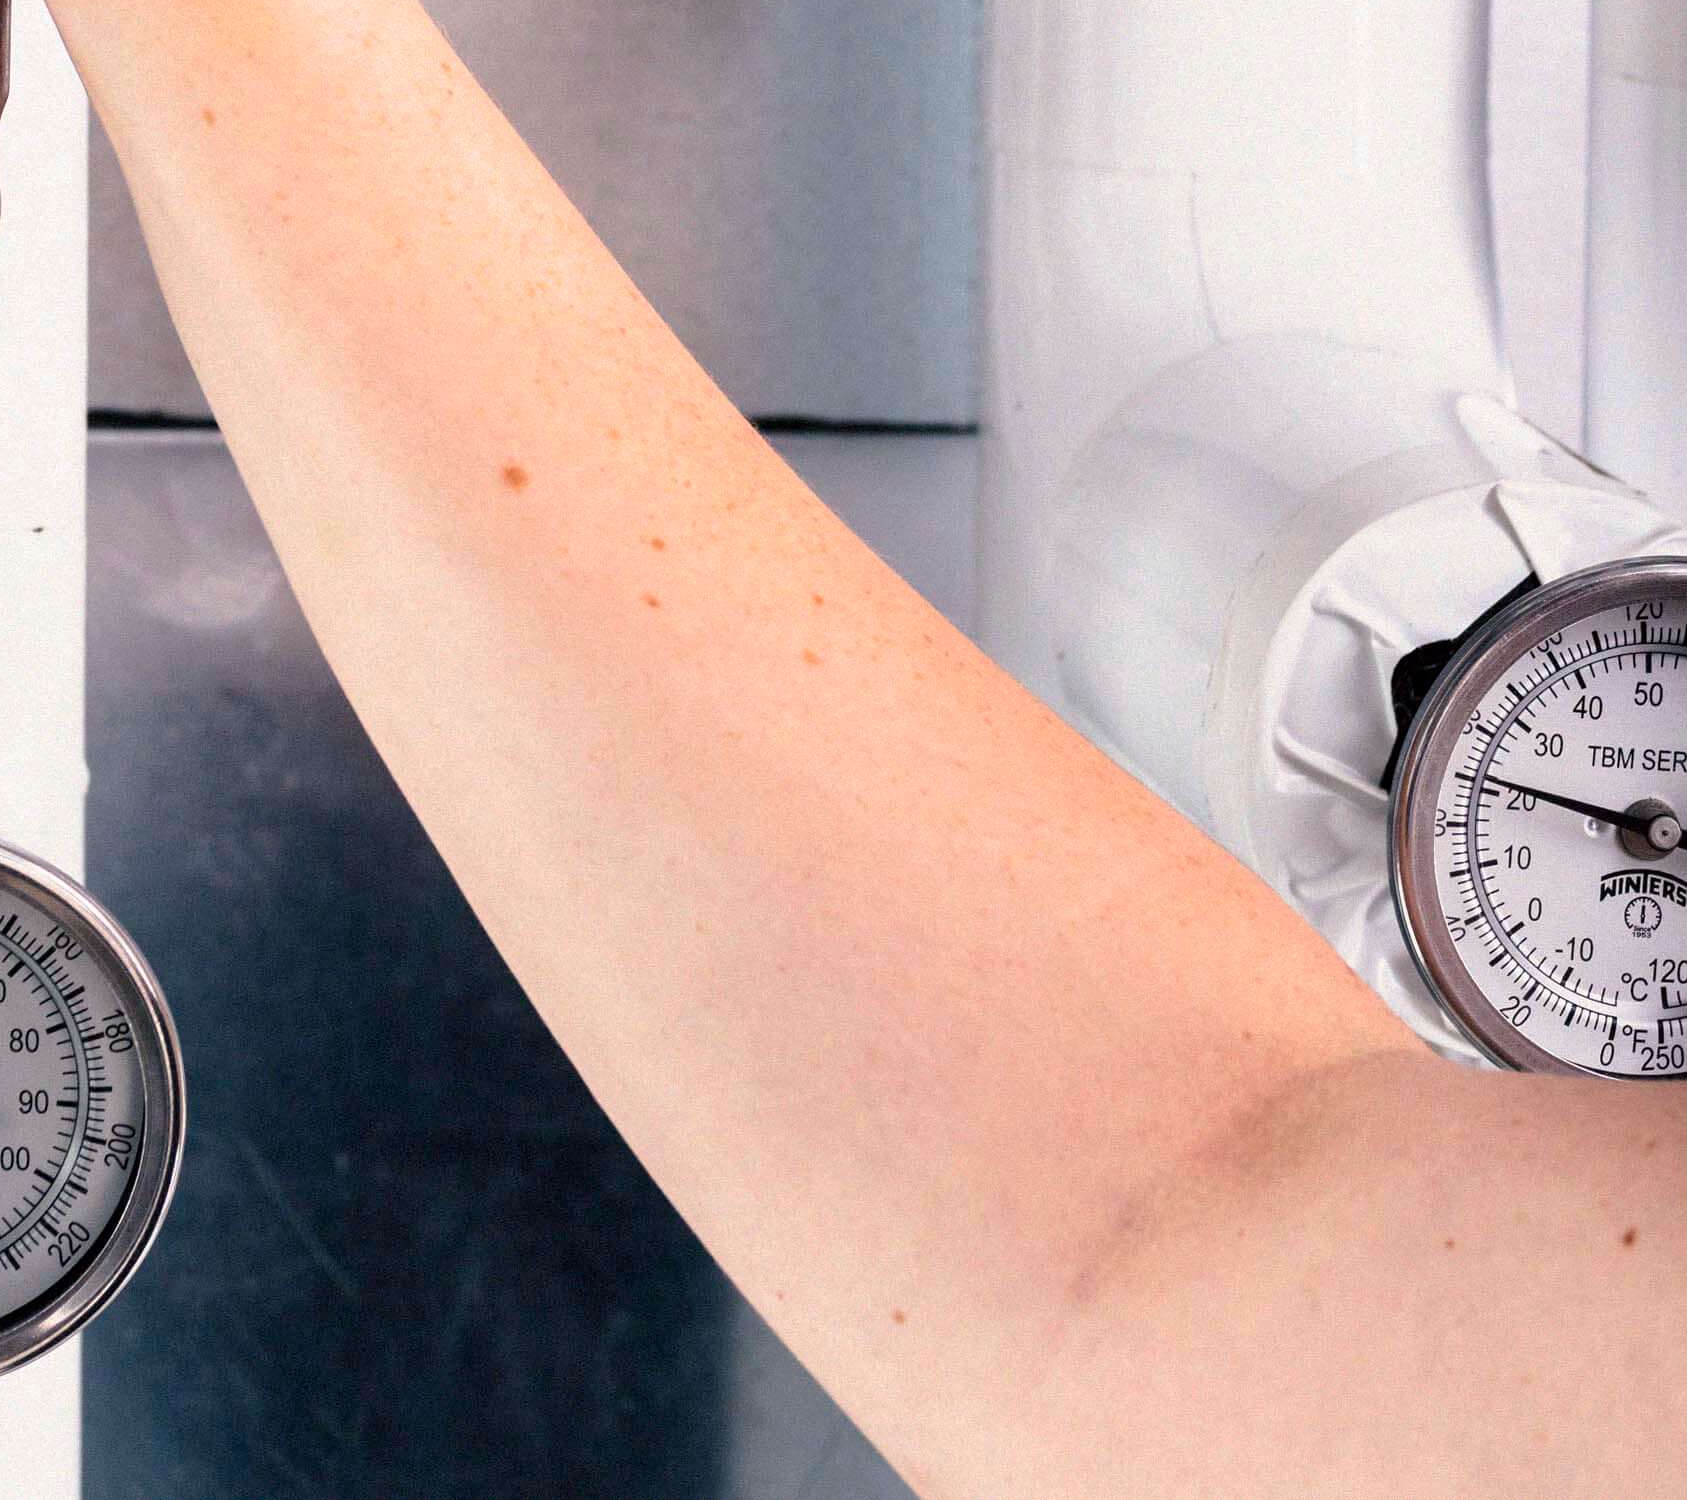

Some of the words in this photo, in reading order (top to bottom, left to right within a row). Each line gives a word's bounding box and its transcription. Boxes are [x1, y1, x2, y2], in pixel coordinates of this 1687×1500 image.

[1634, 683, 1664, 706] 50
[1573, 695, 1604, 720] 40
[1534, 733, 1564, 757] 30
[1588, 746, 1636, 769] TBM
[1505, 846, 1532, 869] 10
[1528, 897, 1542, 921] 0
[1555, 938, 1593, 962] -10
[9, 1028, 40, 1053] 80
[101, 1007, 133, 1054] 180
[19, 1090, 49, 1114] 90
[104, 1124, 137, 1171] 200
[46, 1222, 91, 1268] 220
